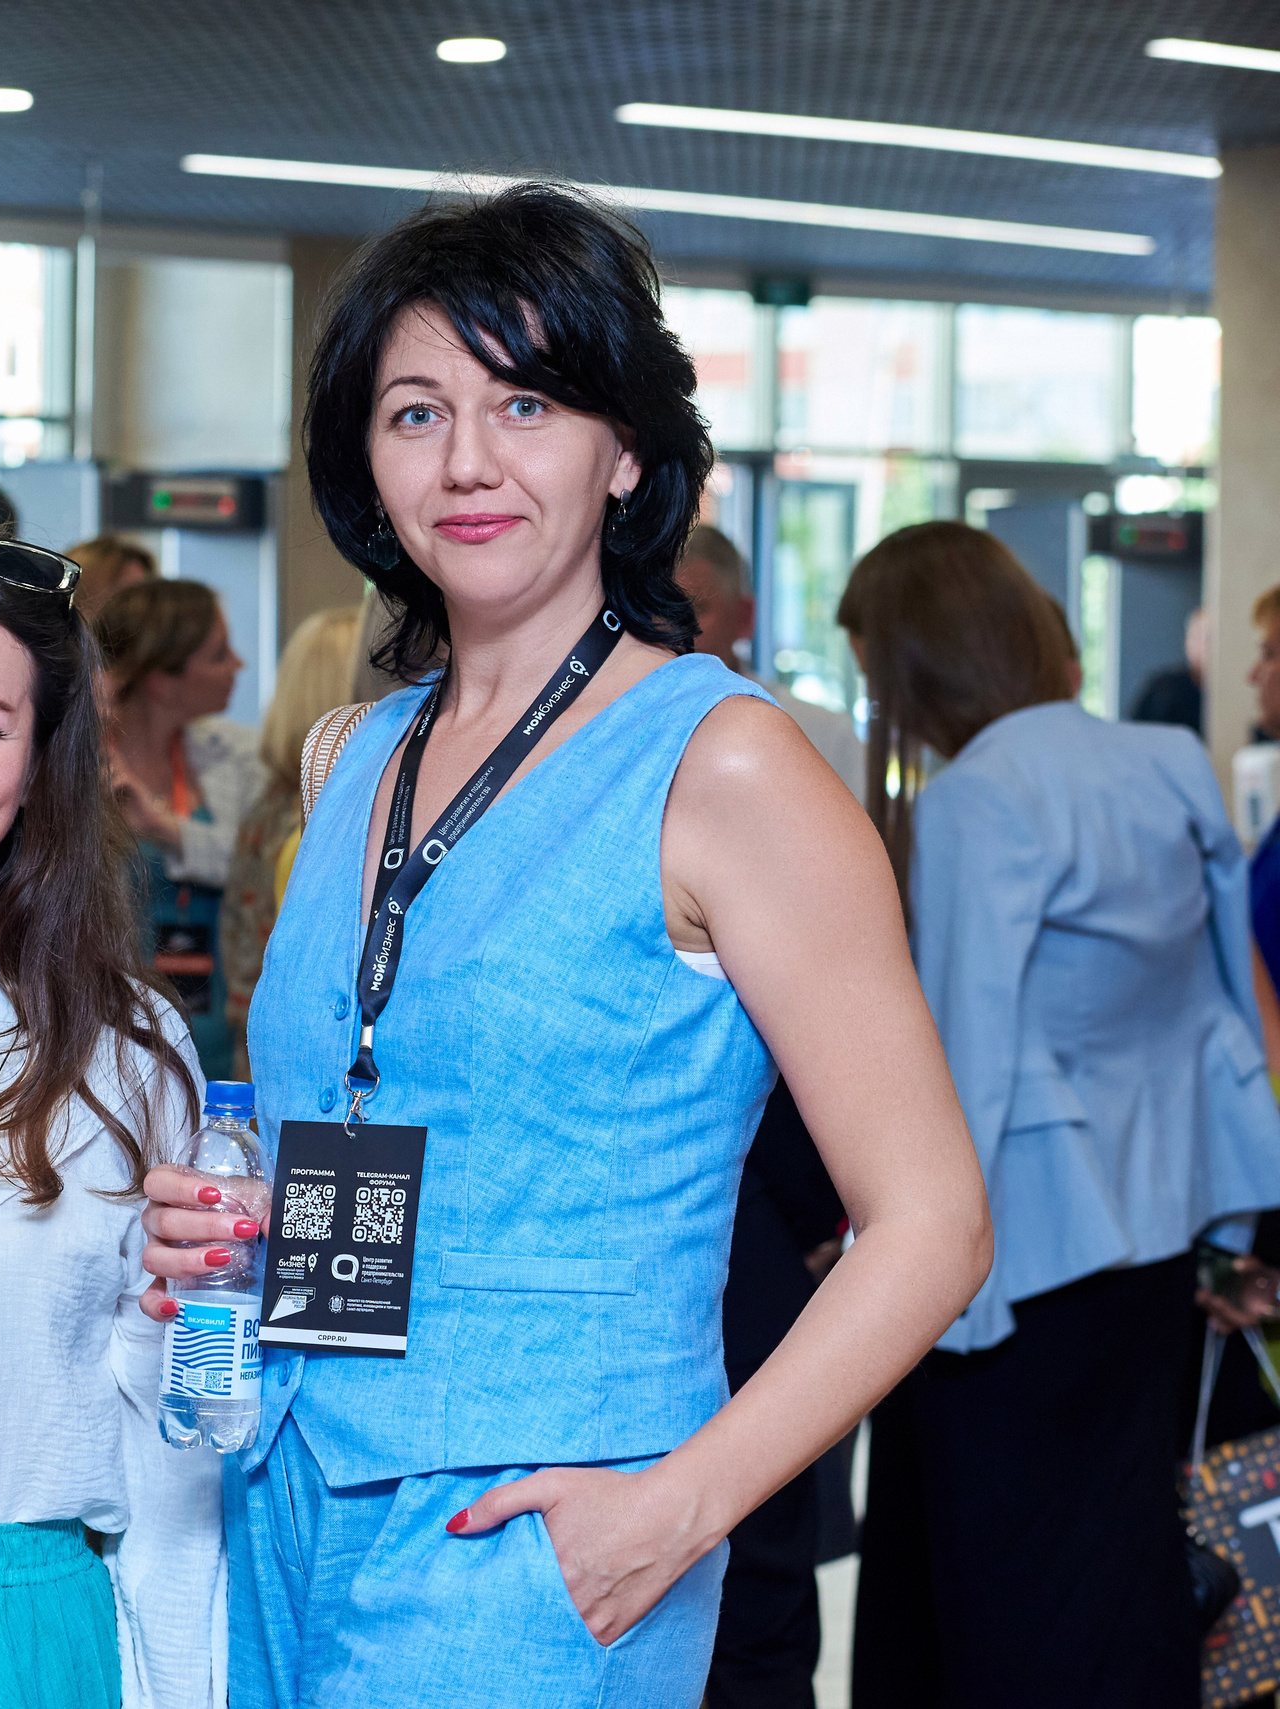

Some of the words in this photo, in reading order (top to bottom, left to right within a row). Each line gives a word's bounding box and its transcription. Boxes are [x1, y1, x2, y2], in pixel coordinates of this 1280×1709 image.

[523, 674, 576, 736] мойбизнес
[370, 917, 397, 991] мойбизнес
[290, 1168, 336, 1177] ПРОГРАММА
[278, 1258, 306, 1268] бизнес
[187, 1316, 225, 1326] ВКУСВИЛЛ
[317, 1334, 348, 1343] CRPP.RU
